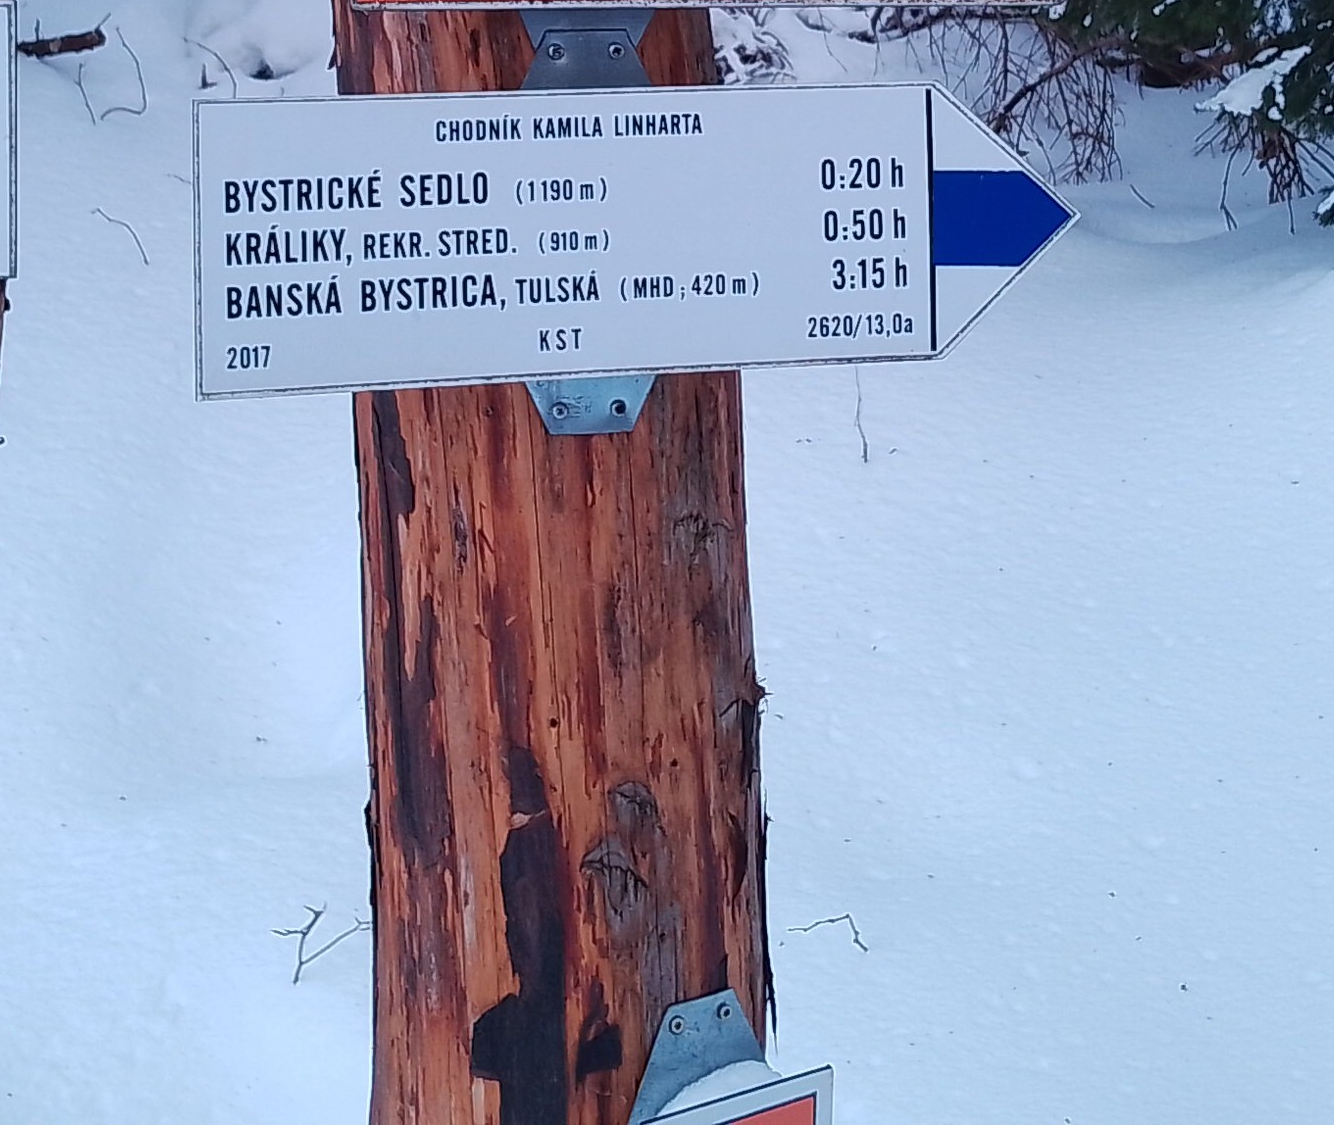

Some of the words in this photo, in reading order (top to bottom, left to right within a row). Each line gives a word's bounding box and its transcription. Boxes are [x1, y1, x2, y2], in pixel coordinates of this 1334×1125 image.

[435, 114, 522, 142] CHODNÍK
[533, 116, 603, 140] KAMILA
[614, 113, 703, 137] LINHARTA
[224, 169, 382, 214] BYSTRICKÉ
[399, 171, 489, 208] SEDLO
[821, 157, 881, 191] 0:20
[890, 157, 904, 188] h
[225, 224, 352, 267] KRÁLIKY,
[363, 231, 431, 261] REKR.
[438, 227, 517, 257] STRED.
[823, 208, 884, 242] 0:50
[893, 208, 906, 239] h
[226, 274, 342, 320] BANSKÁ
[360, 274, 506, 313] BYSTRICA,
[514, 269, 600, 305] TULSKÁ
[832, 257, 885, 290] 3:15
[894, 256, 908, 288] h
[539, 327, 582, 352] KST
[807, 312, 913, 339] 2620/13,0a
[226, 345, 271, 370] 2017
